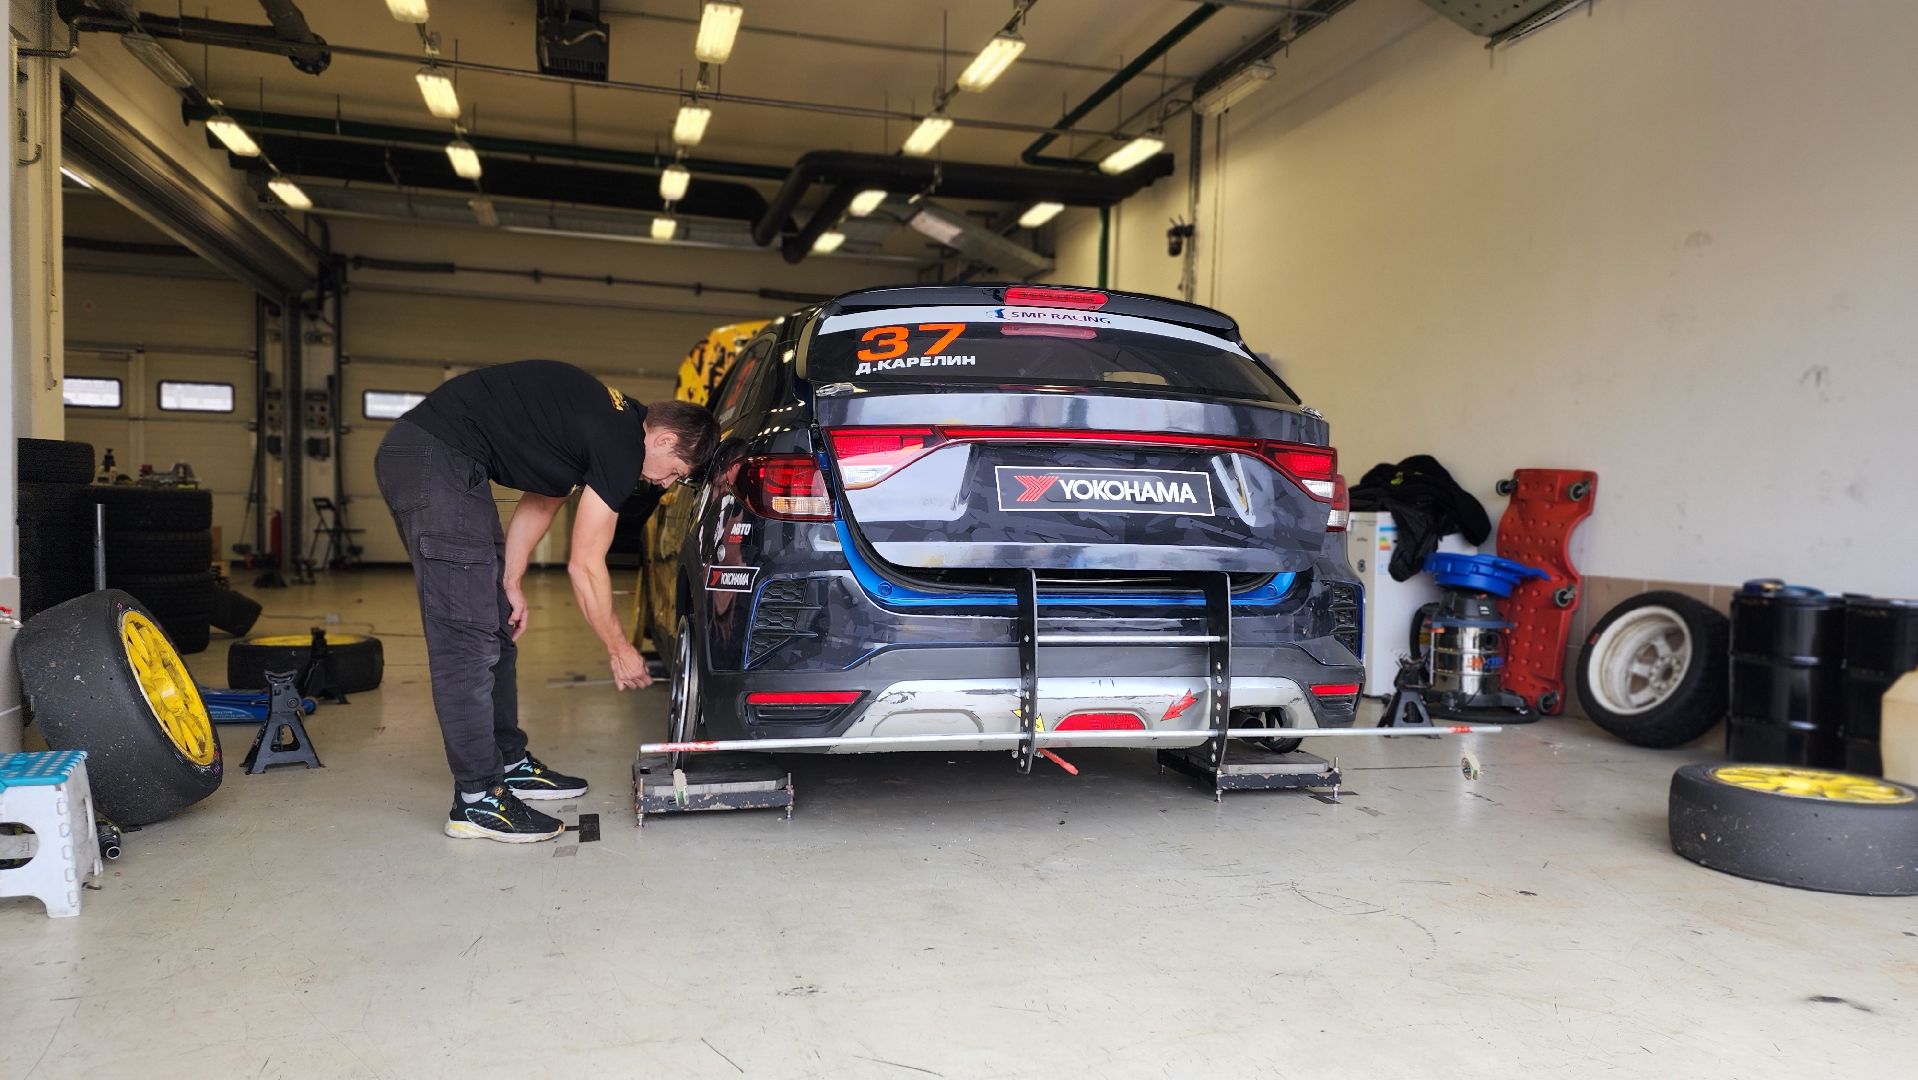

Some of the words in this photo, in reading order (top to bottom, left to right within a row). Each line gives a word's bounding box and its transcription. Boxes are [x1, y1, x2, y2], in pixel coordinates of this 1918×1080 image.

[1011, 311, 1046, 320] SMP
[1051, 312, 1111, 324] RACING
[857, 322, 967, 361] 37
[855, 355, 976, 376] Д.КАРЕЛИН
[1059, 479, 1198, 504] YOKOHAMA
[730, 523, 752, 536] АВТО
[720, 572, 750, 586] YOKOHAMA
